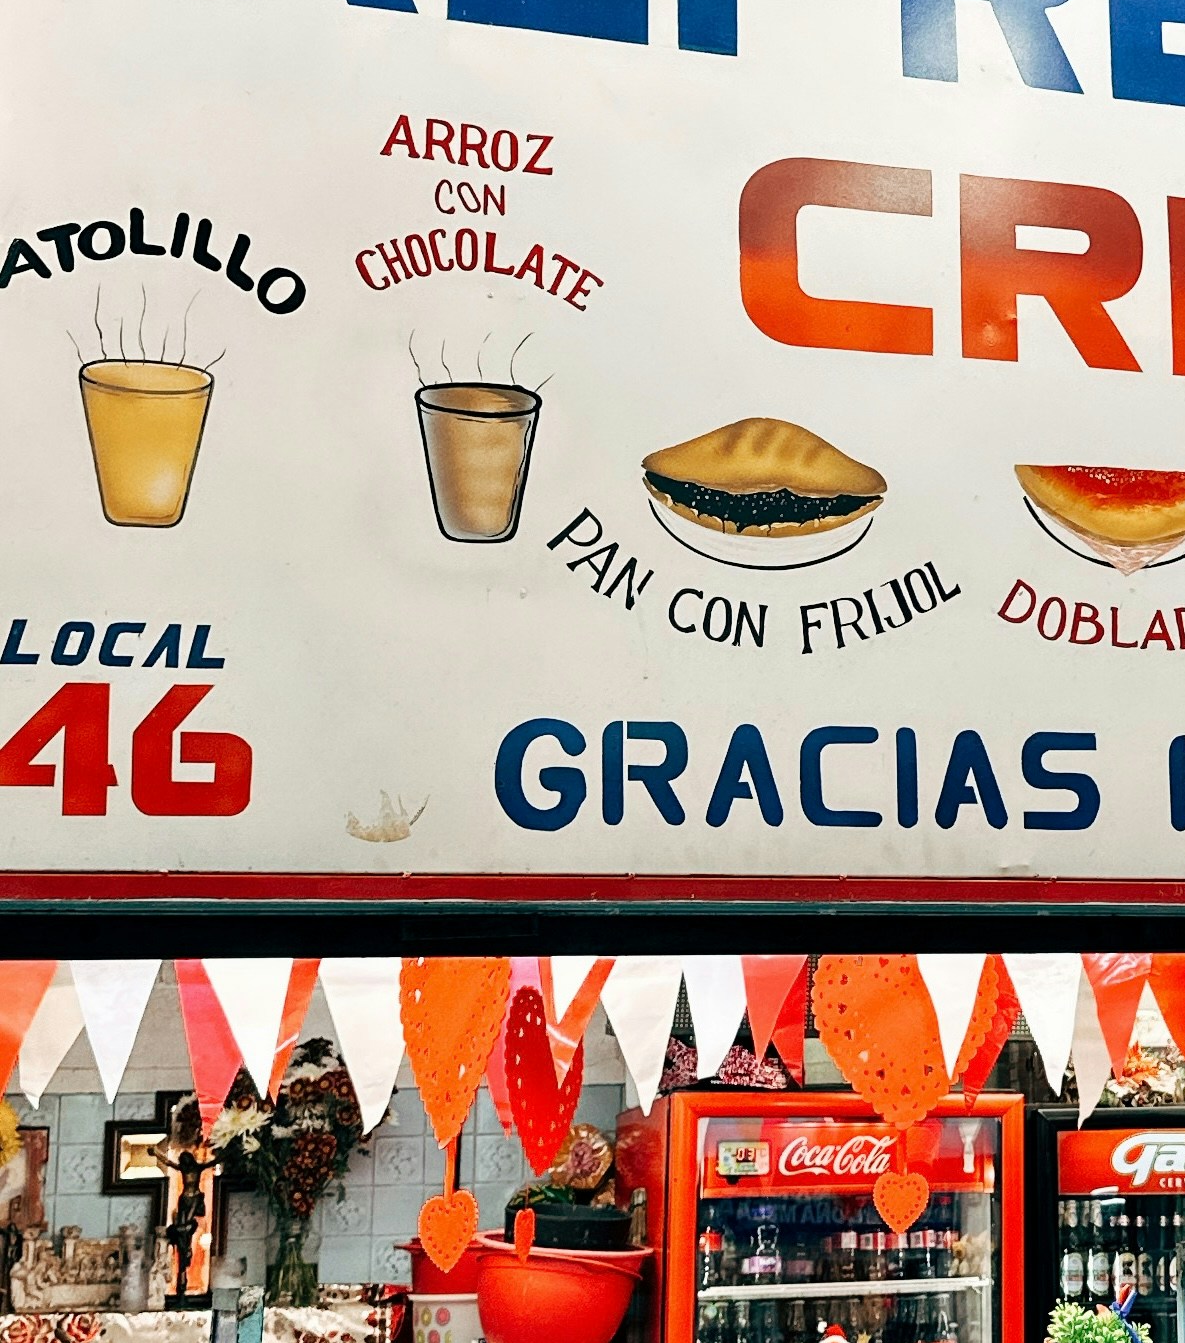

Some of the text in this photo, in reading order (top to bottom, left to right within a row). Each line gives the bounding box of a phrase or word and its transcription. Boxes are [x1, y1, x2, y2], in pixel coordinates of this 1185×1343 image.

[380, 114, 554, 176] ARROZ
[433, 179, 507, 217] CON
[0, 207, 307, 315] ATOLILLO
[355, 227, 604, 312] CHOCOLATE
[546, 506, 962, 654] PAN CON FRIJOL
[0, 618, 226, 670] LOCAL
[0, 682, 253, 817] 46
[494, 717, 1101, 833] GRACIAS
